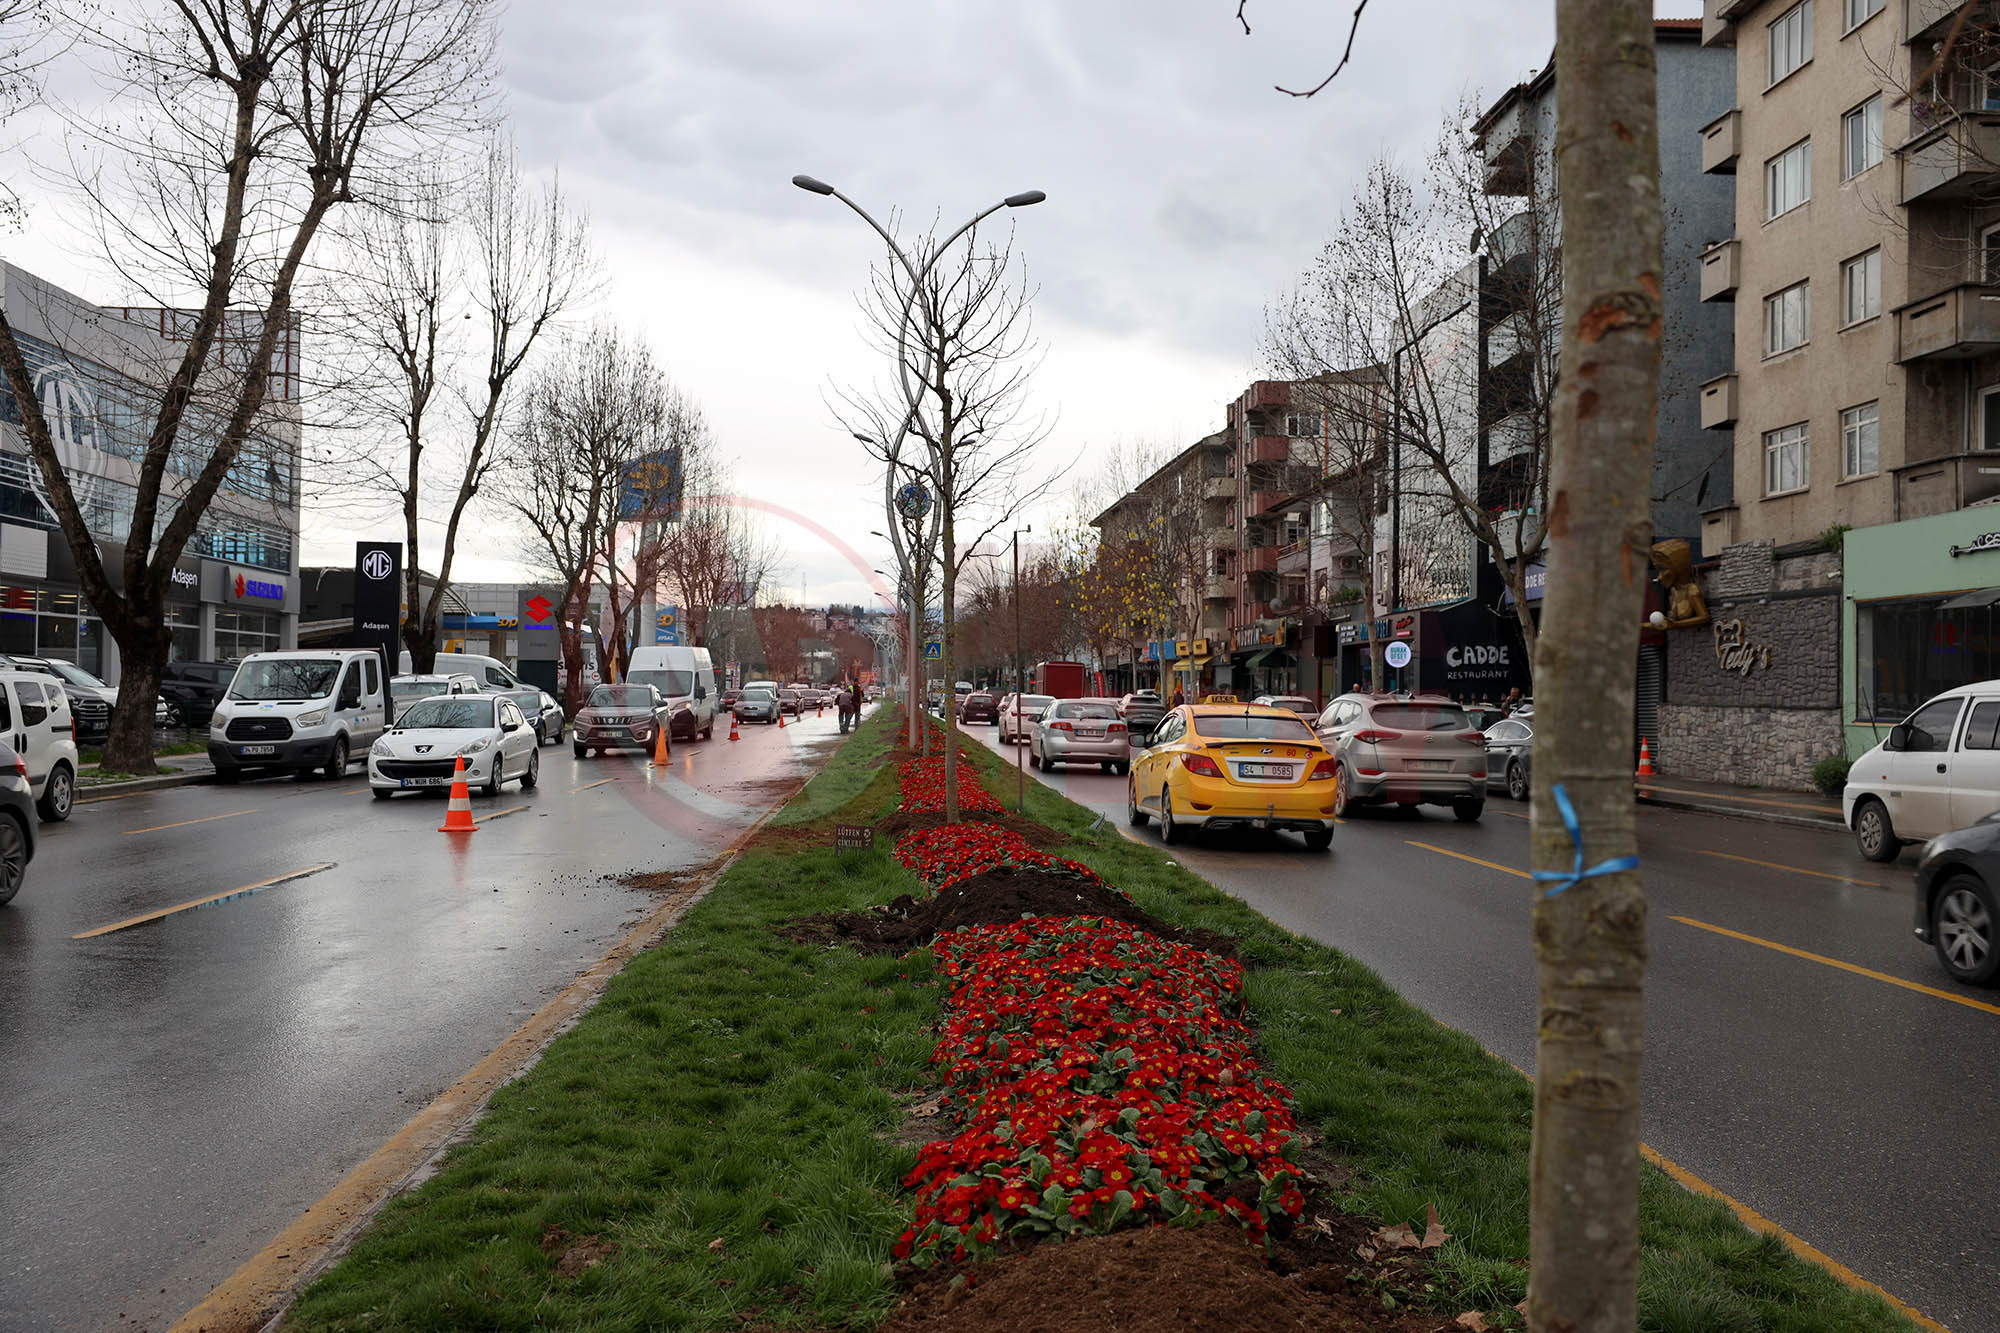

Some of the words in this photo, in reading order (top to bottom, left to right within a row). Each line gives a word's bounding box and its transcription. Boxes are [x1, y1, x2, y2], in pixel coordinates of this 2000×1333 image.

[364, 552, 391, 578] MG
[171, 568, 198, 588] Adaşen
[246, 580, 283, 600] SUZUKI
[362, 621, 390, 631] Adaşen
[1446, 645, 1510, 667] CADDE
[1447, 670, 1509, 680] RESTAURANT
[1286, 749, 1297, 757] 60
[1244, 765, 1254, 774] 54
[1260, 766, 1265, 775] T
[1272, 766, 1291, 776] 0585
